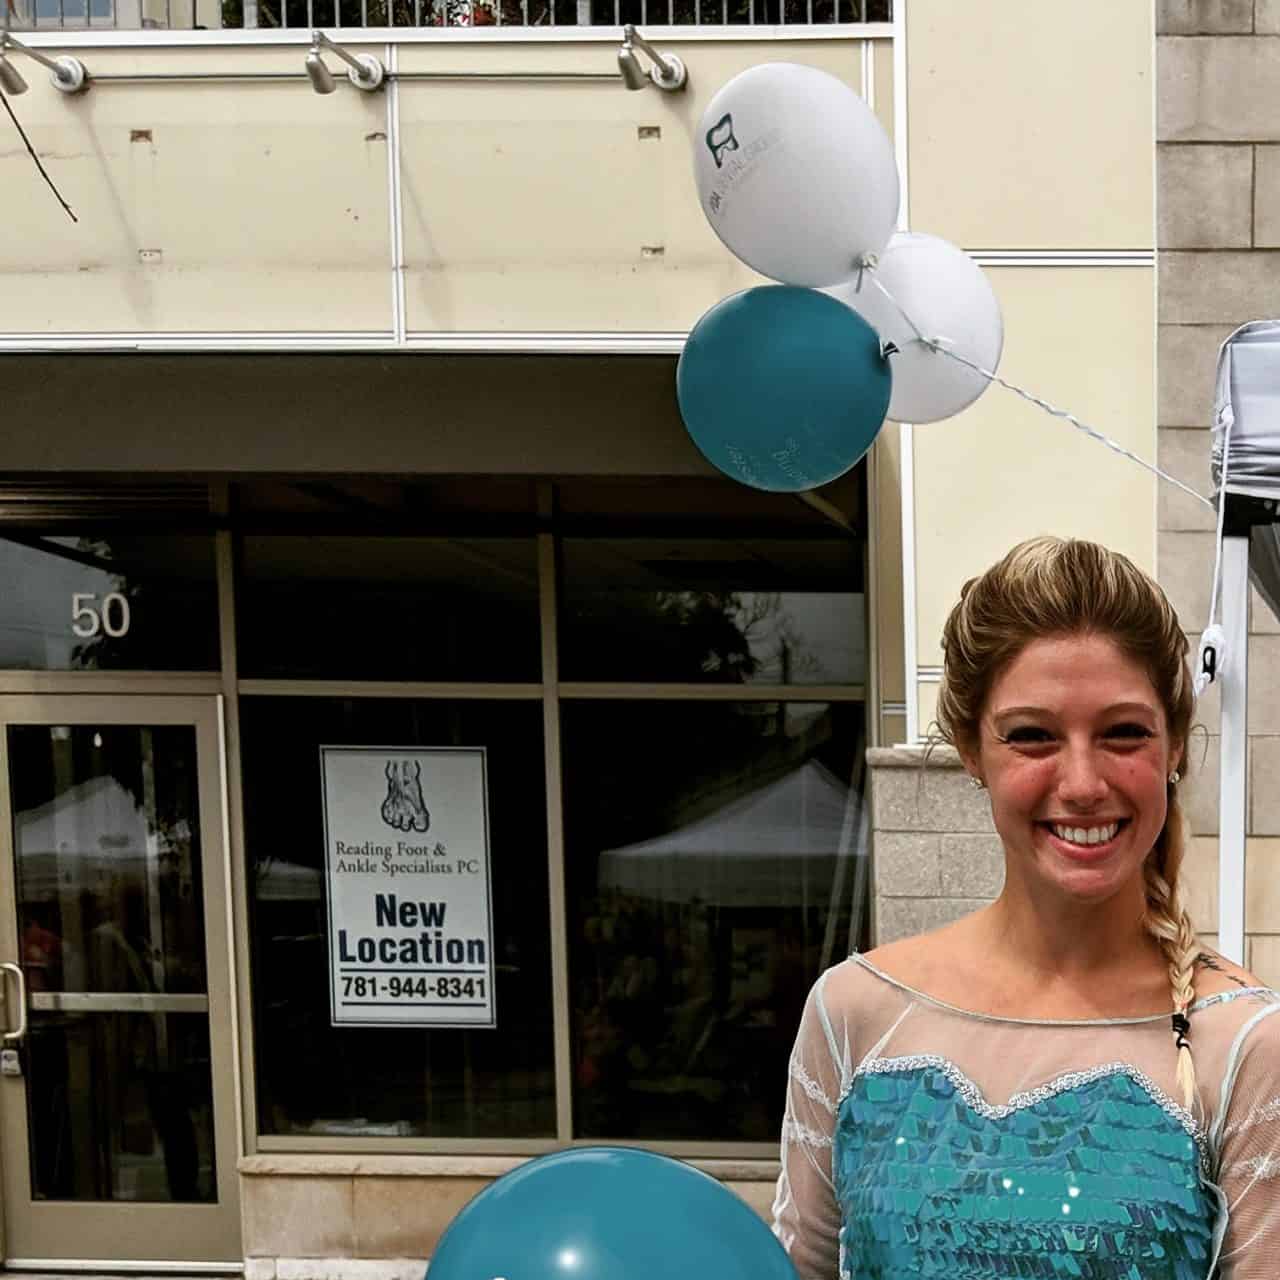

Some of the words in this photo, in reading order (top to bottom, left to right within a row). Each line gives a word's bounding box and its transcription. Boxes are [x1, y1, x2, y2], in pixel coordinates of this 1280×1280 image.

[72, 592, 130, 637] 50
[336, 841, 392, 862] Reading
[397, 841, 428, 856] Foot
[433, 842, 447, 856] &
[336, 859, 377, 873] Ankle
[382, 859, 453, 877] Specialists
[457, 860, 480, 874] PC
[375, 894, 446, 927] New
[338, 930, 486, 964] Location
[341, 976, 486, 998] 781-944-8341
